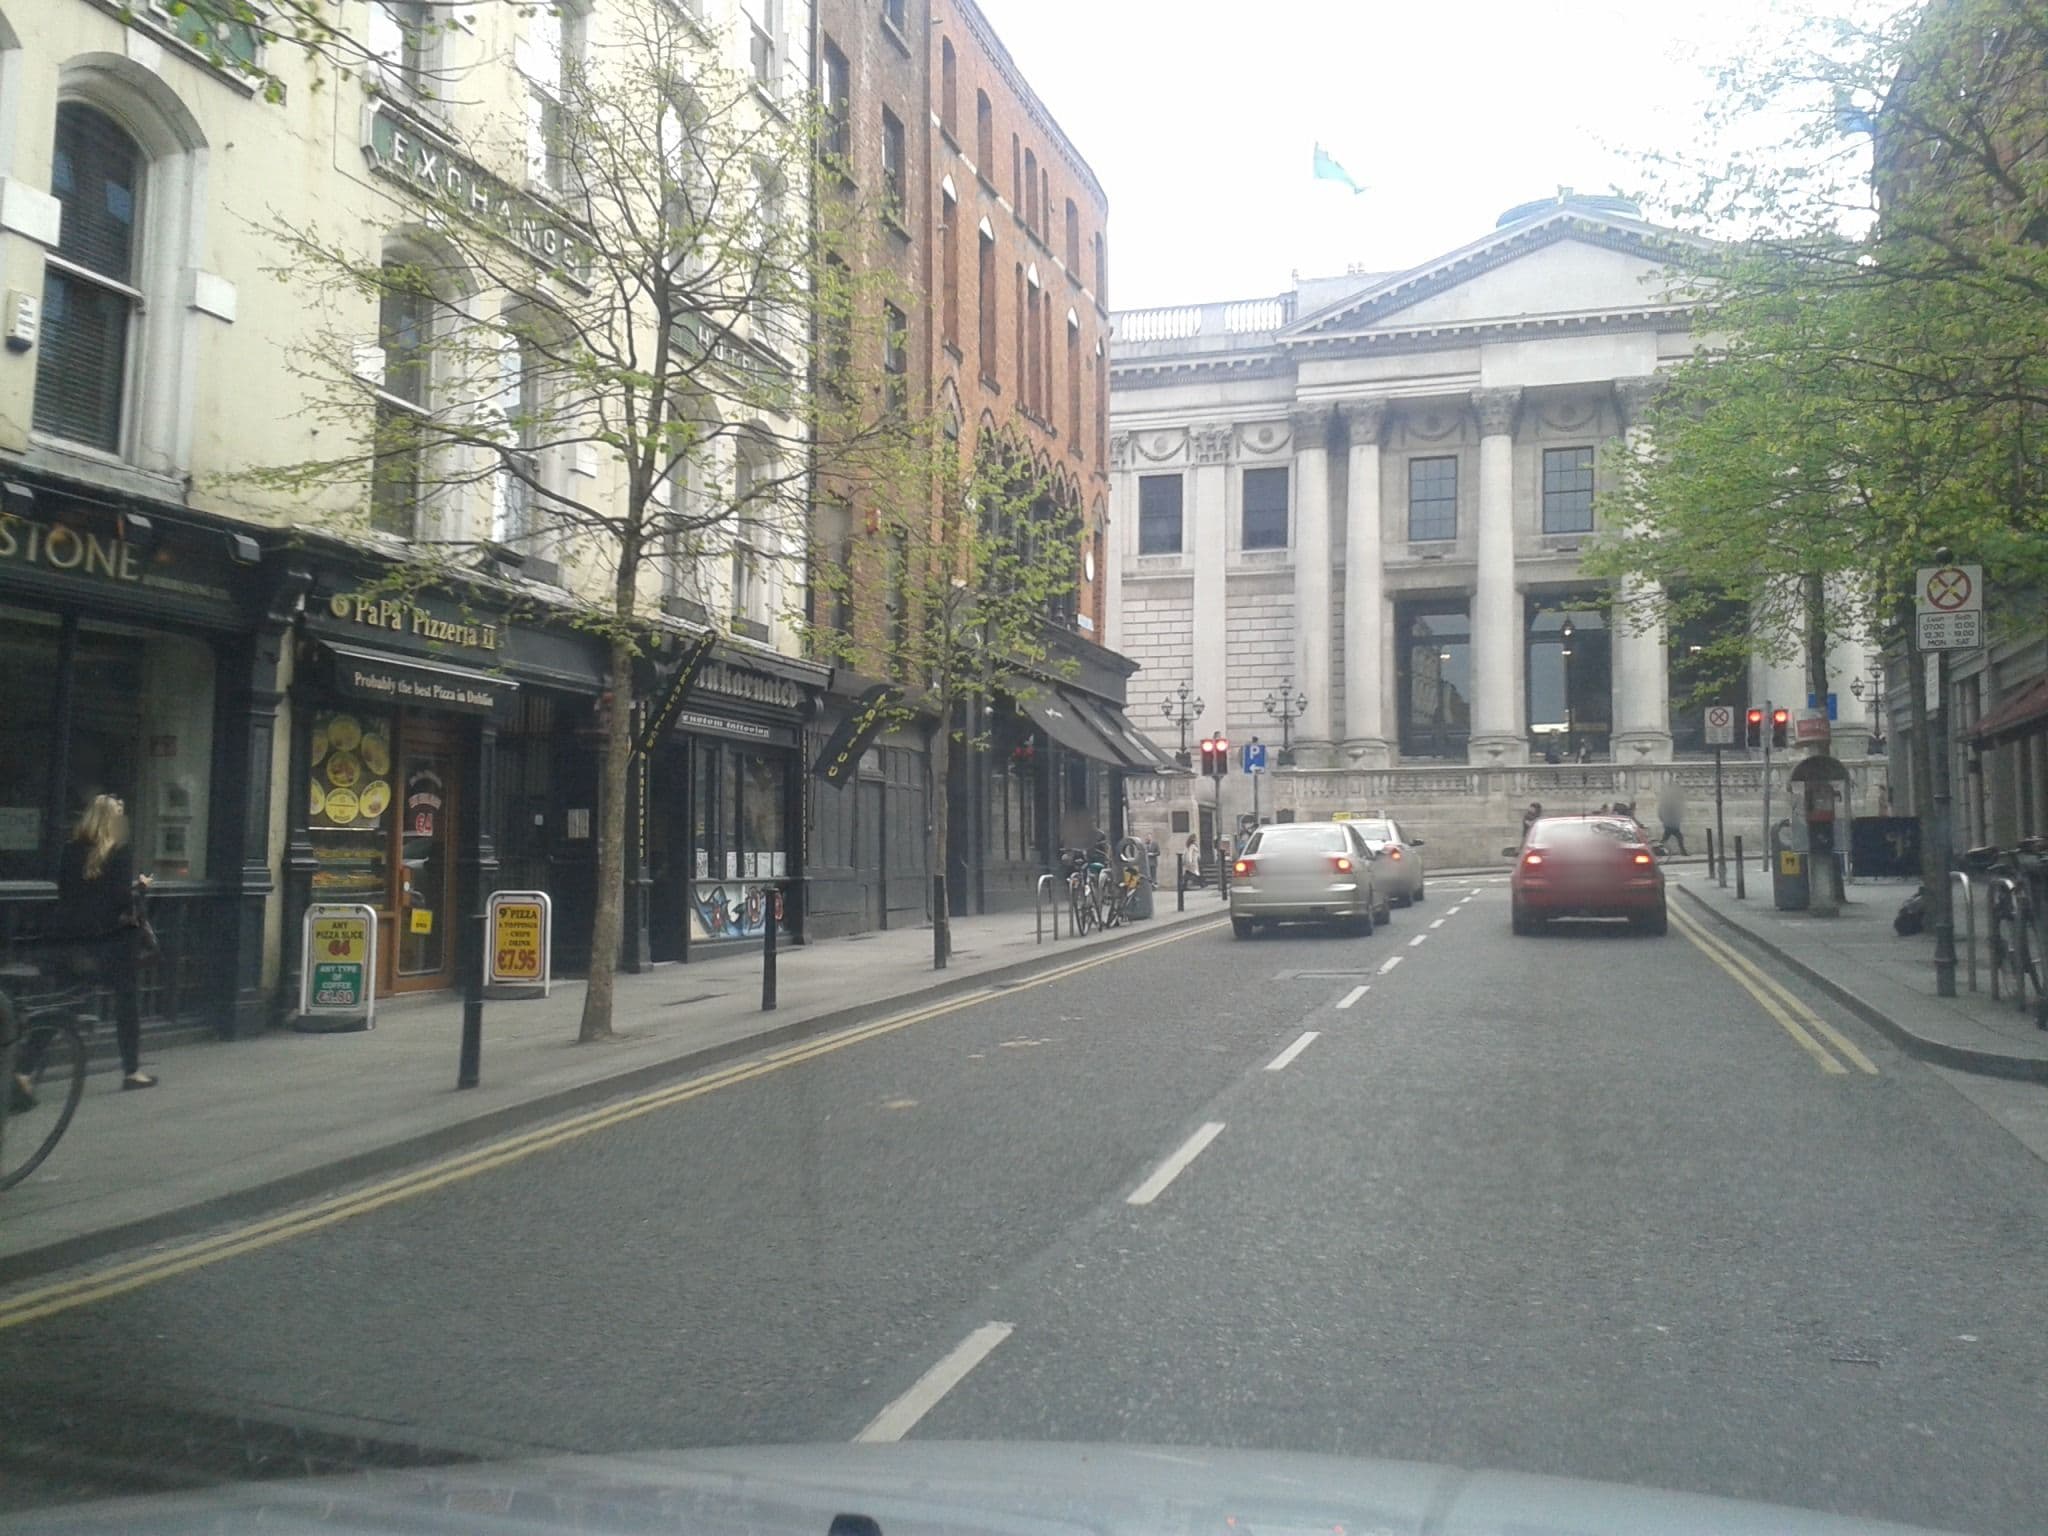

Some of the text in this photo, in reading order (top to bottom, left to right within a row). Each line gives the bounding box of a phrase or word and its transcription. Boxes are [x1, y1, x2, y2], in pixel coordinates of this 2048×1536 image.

[394, 131, 575, 268] EXCHANGE
[412, 607, 478, 646] Pizzeria
[354, 671, 396, 694] Probably
[398, 679, 412, 694] the
[414, 682, 431, 697] best
[433, 685, 456, 701] Pizza
[467, 690, 493, 707] Dublin
[1250, 744, 1259, 759] P
[511, 909, 537, 919] PIZZA
[497, 949, 537, 970] €7.95
